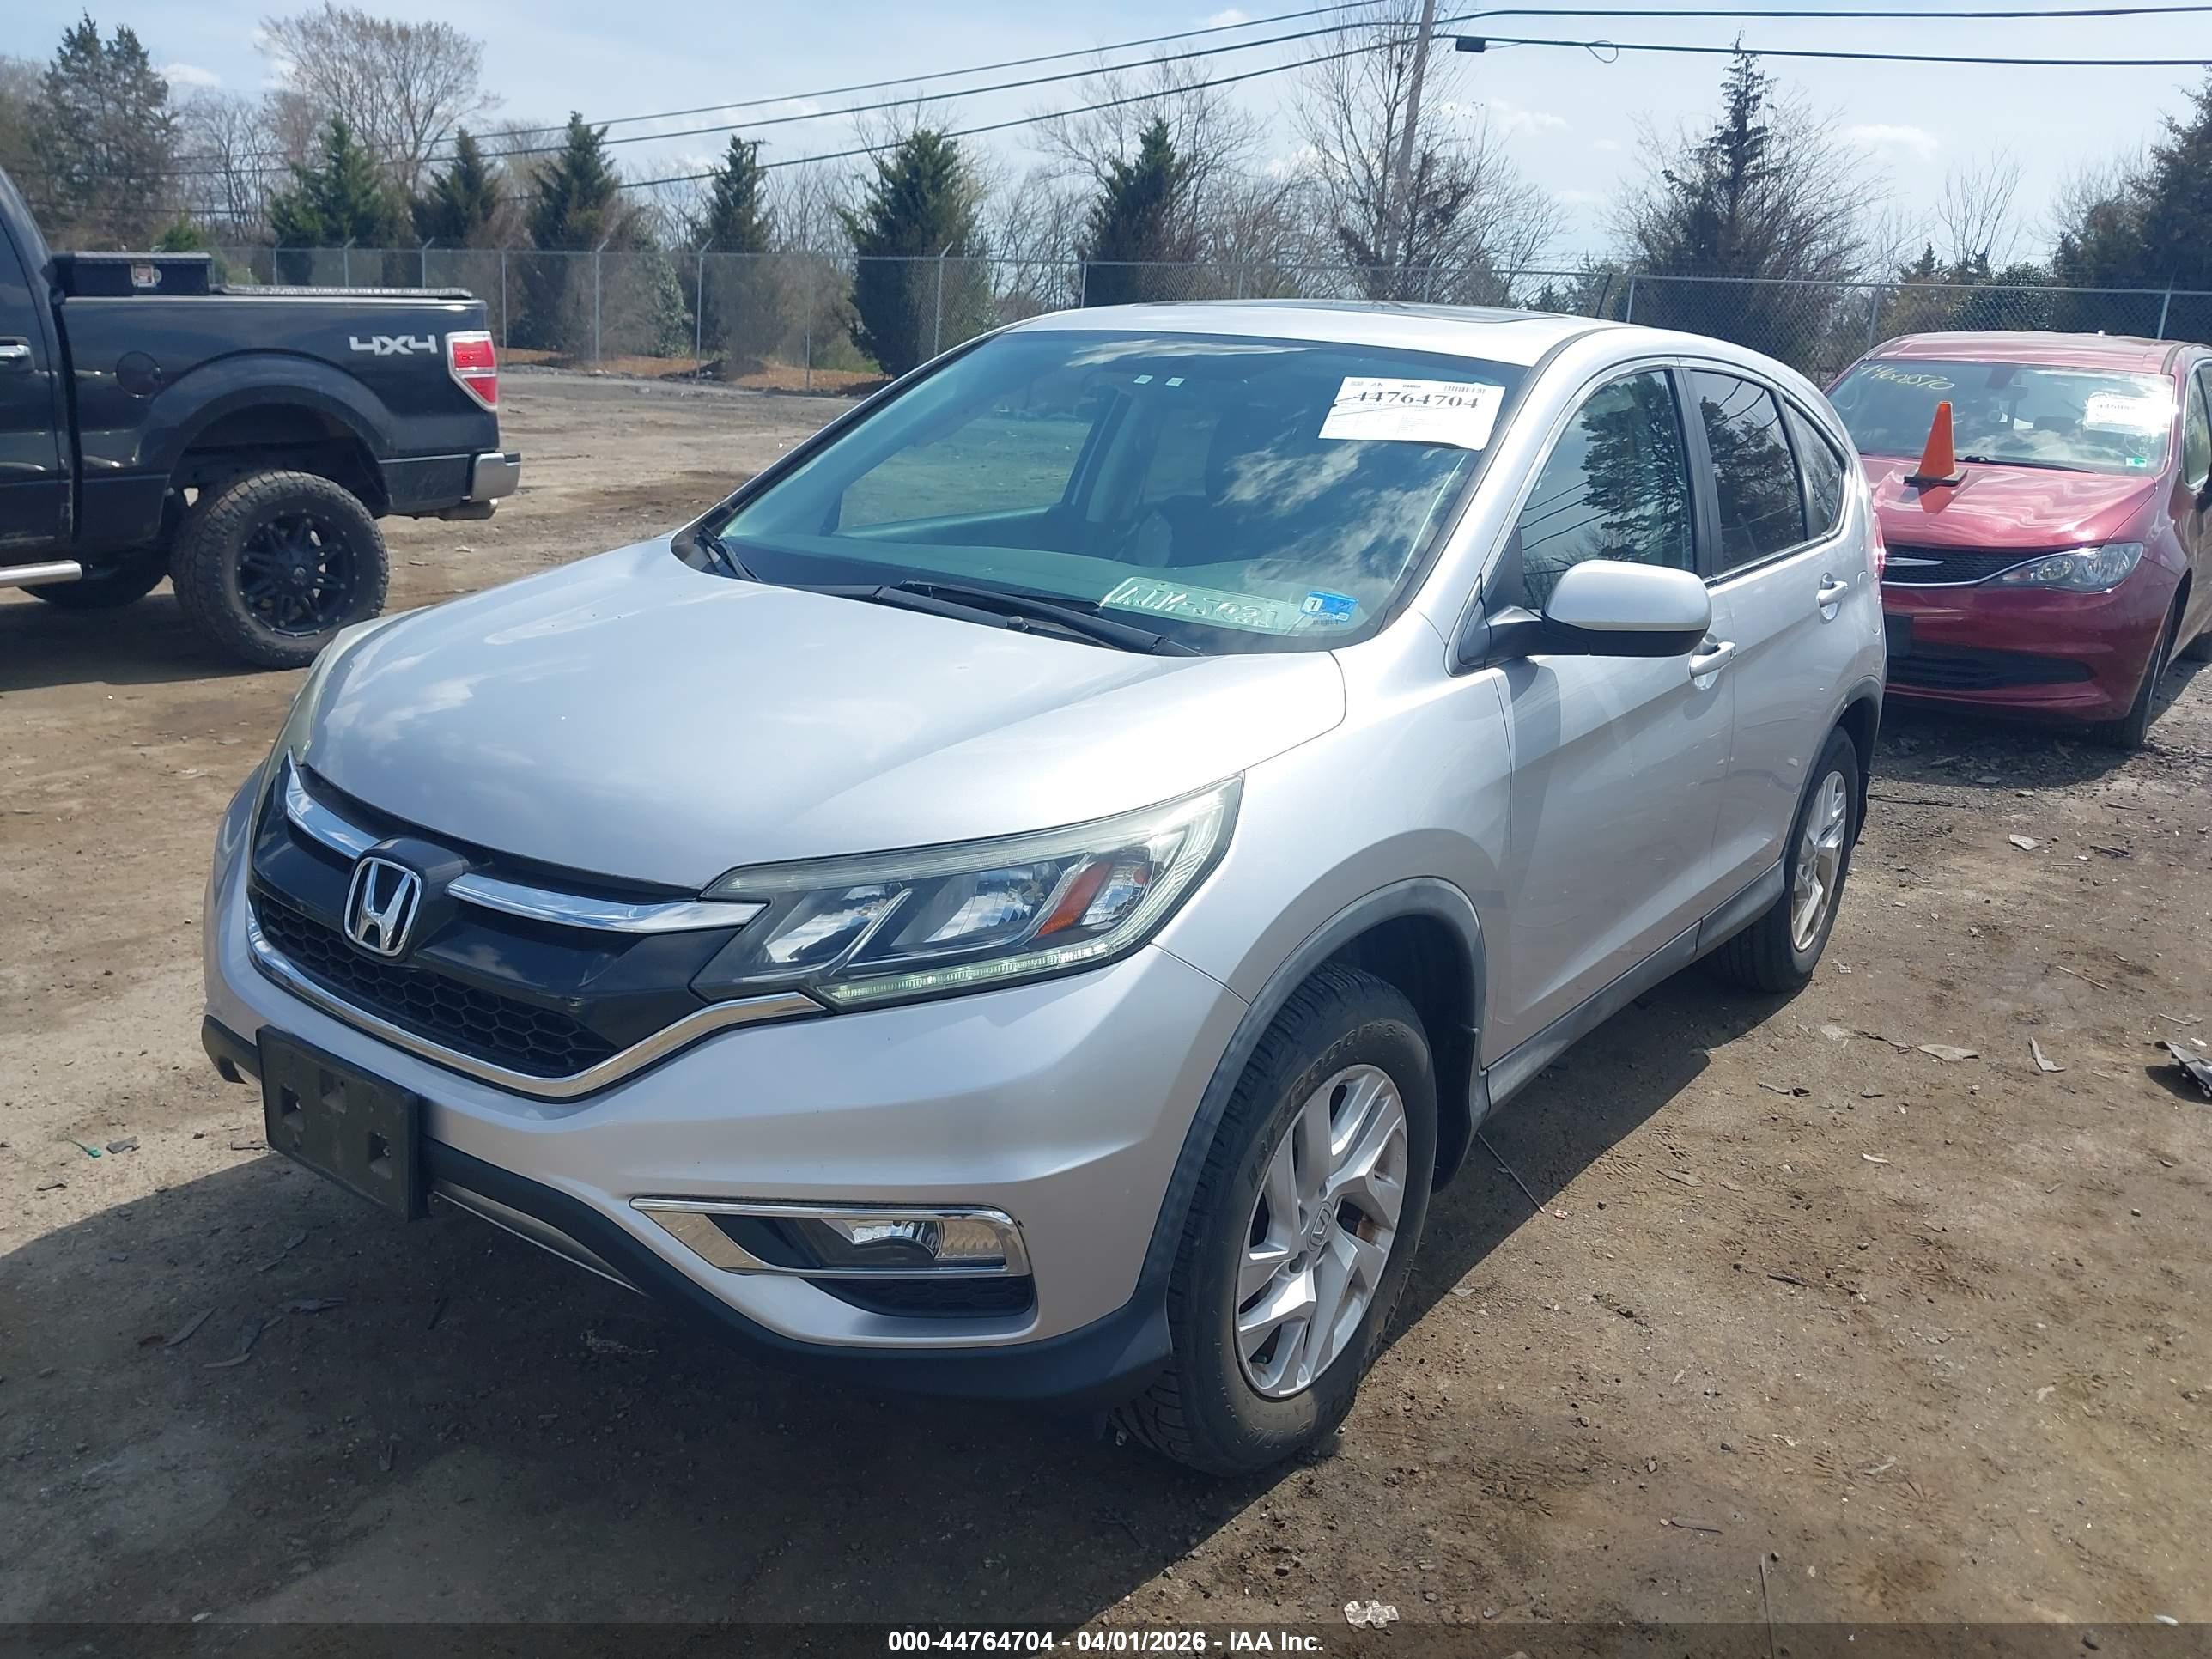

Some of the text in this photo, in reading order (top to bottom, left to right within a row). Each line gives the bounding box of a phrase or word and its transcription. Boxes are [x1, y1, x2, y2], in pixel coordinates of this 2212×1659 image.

[349, 334, 438, 356] 4X4
[1352, 391, 1480, 409] 44764704
[1310, 599, 1318, 611] 1
